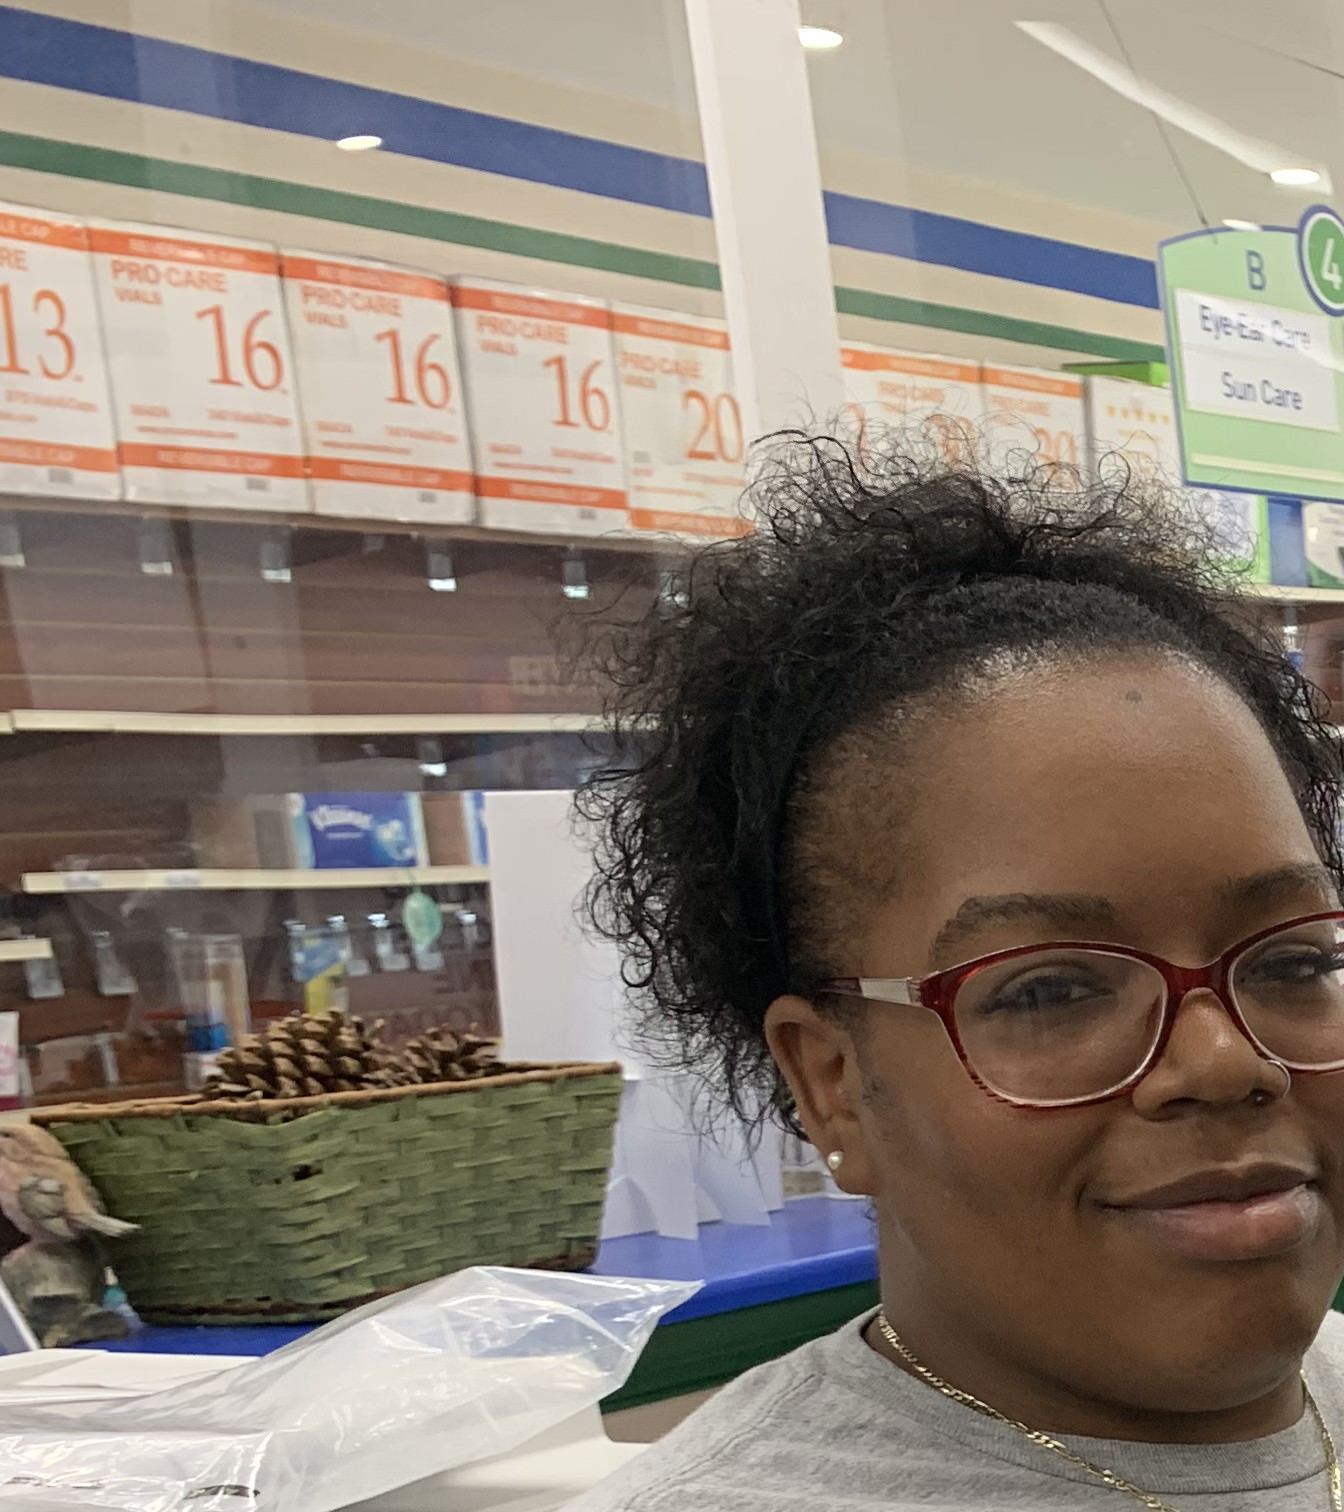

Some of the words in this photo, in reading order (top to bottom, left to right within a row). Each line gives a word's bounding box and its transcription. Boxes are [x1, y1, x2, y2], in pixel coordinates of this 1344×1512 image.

[1246, 249, 1266, 291] B
[1321, 238, 1343, 290] 4
[195, 303, 284, 392] 16
[373, 328, 453, 410] 16
[541, 354, 611, 432] 16
[682, 388, 745, 464] 20
[1221, 371, 1255, 402] Sun
[1261, 379, 1303, 411] Care
